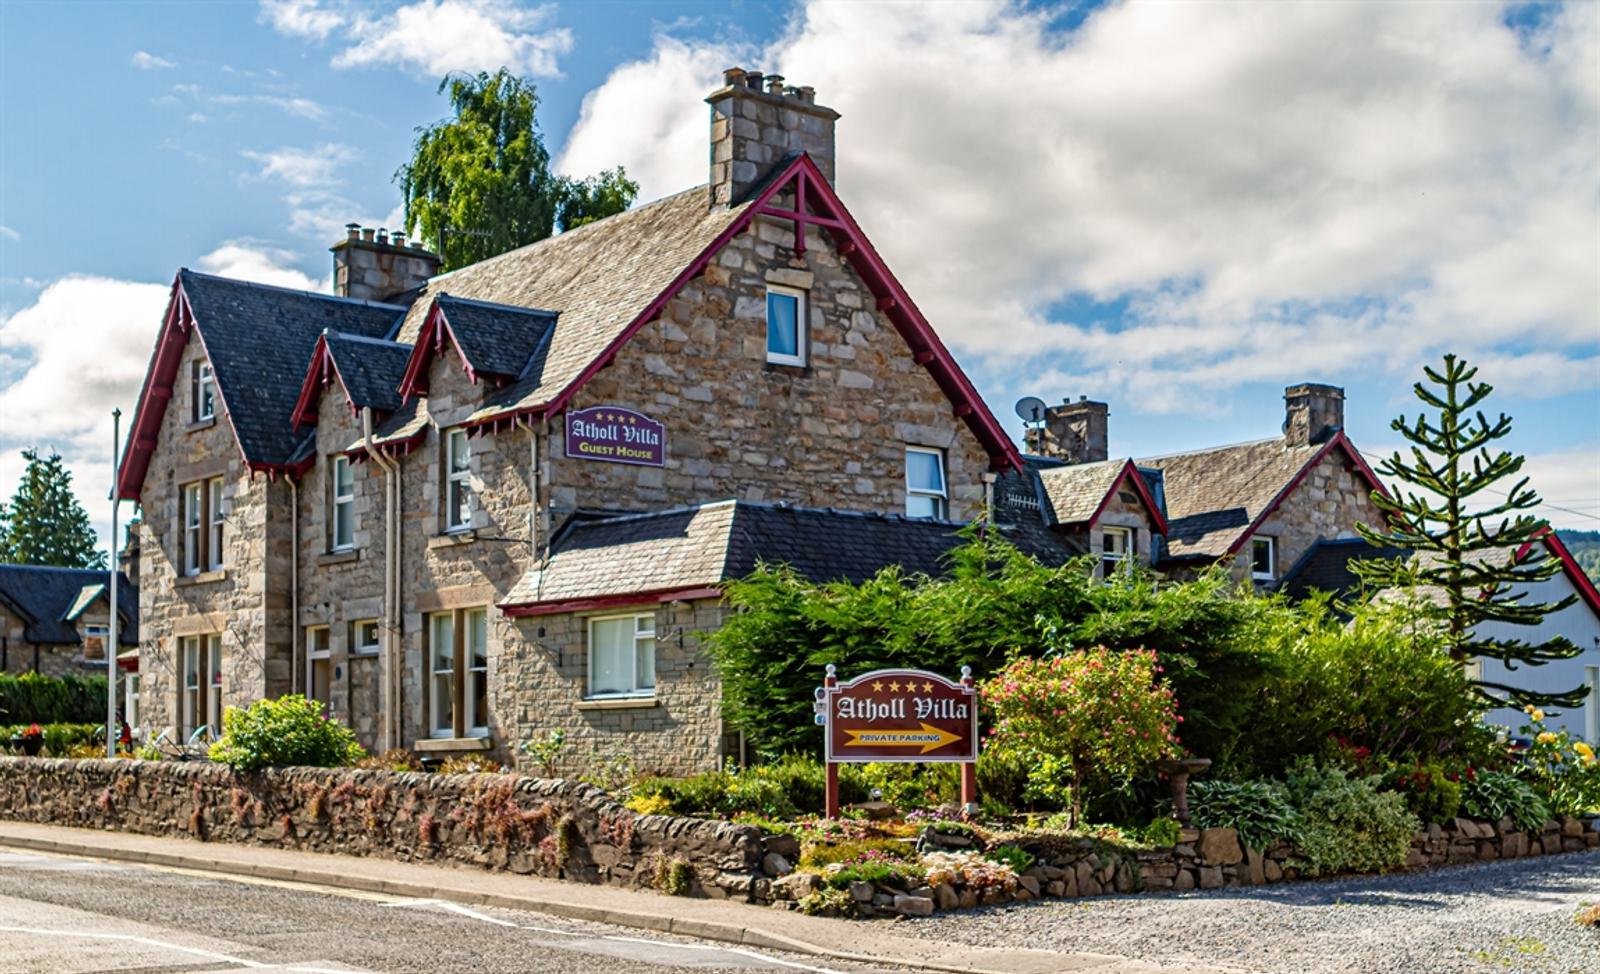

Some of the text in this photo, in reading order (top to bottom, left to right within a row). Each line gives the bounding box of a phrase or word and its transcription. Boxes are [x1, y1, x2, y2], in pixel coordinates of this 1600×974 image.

[572, 419, 659, 445] Atholl Villa
[579, 442, 653, 459] GUEST HOUSE
[837, 696, 968, 723] Atholl Villa
[859, 734, 940, 743] PRIVATE PARKING
